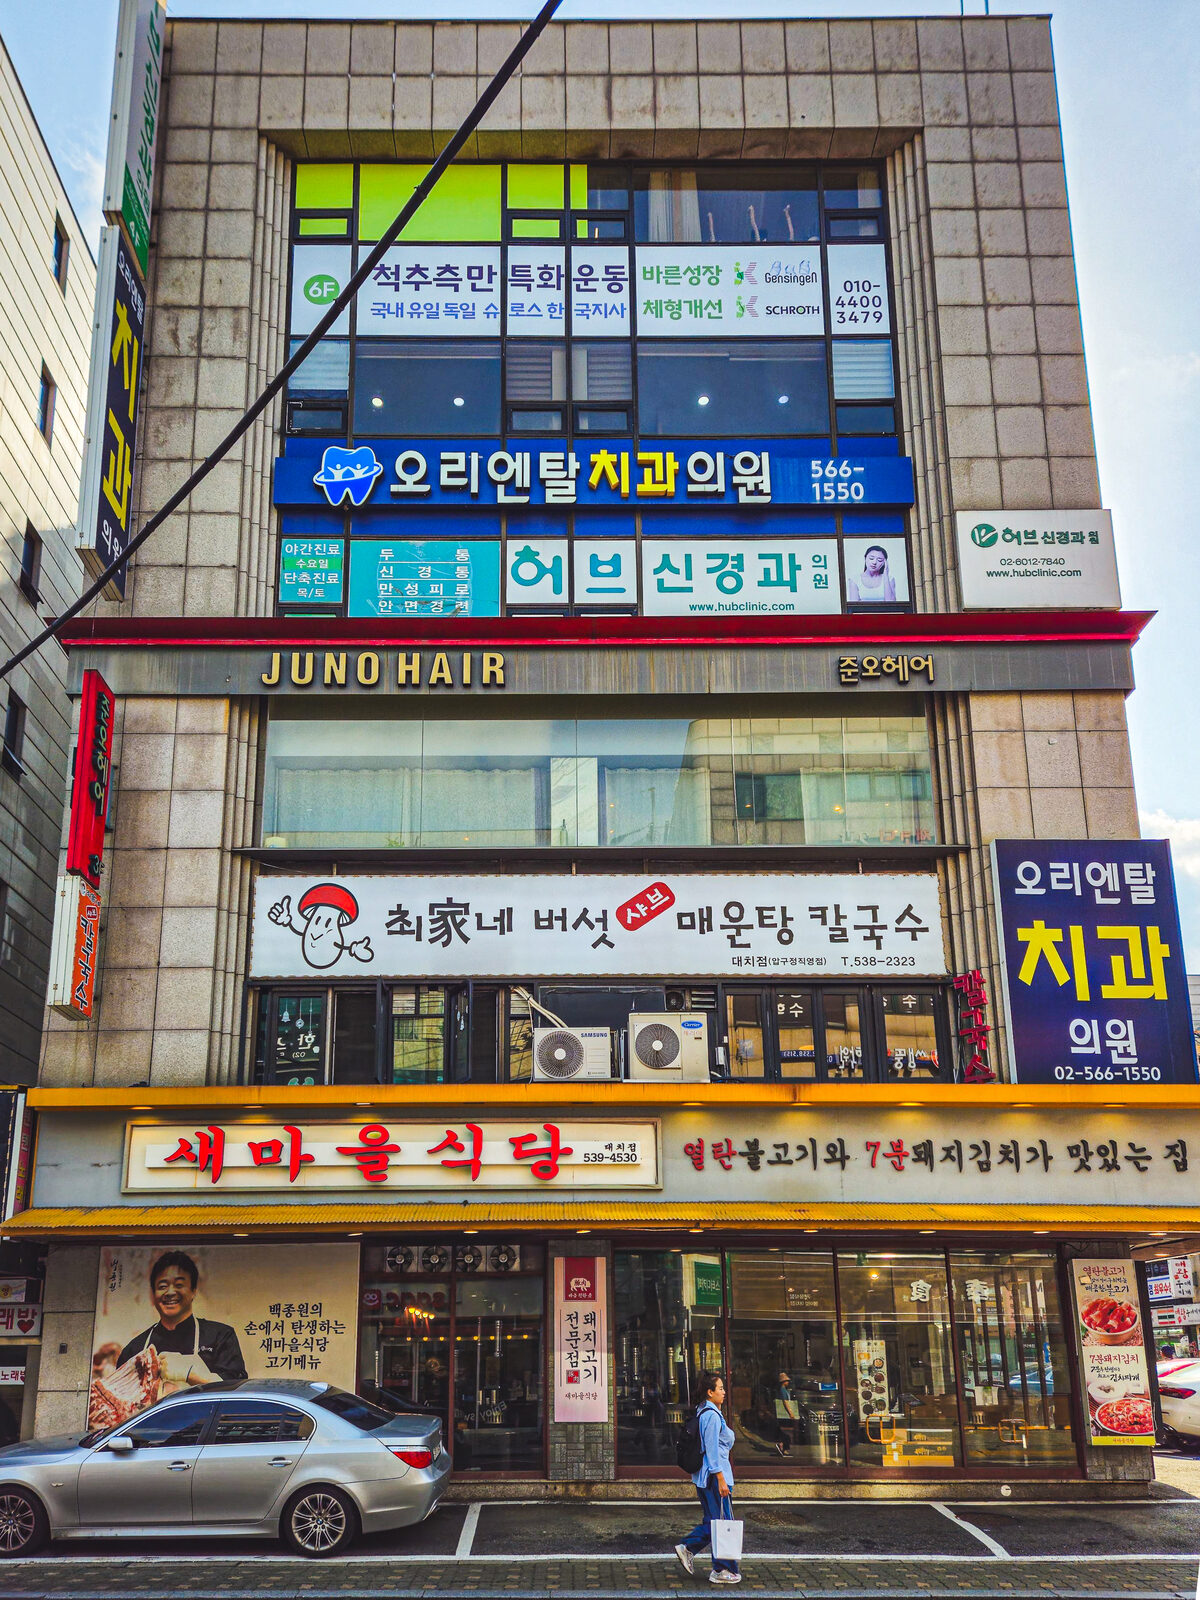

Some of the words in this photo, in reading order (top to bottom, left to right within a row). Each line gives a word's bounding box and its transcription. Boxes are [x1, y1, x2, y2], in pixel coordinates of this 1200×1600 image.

[372, 263, 498, 293] 척추측만
[508, 264, 566, 292] 특화
[572, 264, 629, 294] 운동
[641, 262, 723, 286] 바른성장
[308, 281, 336, 298] 6F
[843, 279, 881, 293] 010-
[642, 299, 723, 321] 체형개선
[765, 305, 820, 315] SCHROTH
[835, 295, 882, 308] 4400
[836, 311, 883, 324] 3479
[102, 298, 139, 532] 치과
[811, 459, 865, 478] 566-
[811, 482, 865, 501] 1550
[1001, 527, 1039, 546] 허브
[1041, 530, 1086, 546] 신경과
[284, 543, 341, 556] 야간진료
[295, 558, 329, 570] 수요일
[986, 568, 1082, 578] www.hubclinic.com
[284, 571, 340, 586] 단축진료
[652, 552, 802, 596] 신경과
[297, 587, 326, 598] 목/토
[688, 601, 795, 613] www.hubclinic.com
[261, 651, 380, 686] JUNO
[396, 651, 506, 685] HAIR
[838, 655, 936, 685] 준오헤어
[1015, 861, 1156, 905] 오리엔탈
[626, 887, 671, 926] 샤브
[534, 907, 616, 950] 버섯
[676, 901, 795, 949] 매운탕
[808, 903, 930, 950] 칼국수
[73, 914, 97, 1011] 칼국수
[1016, 920, 1170, 1001] 치과
[682, 1021, 703, 1030] Carrier
[952, 969, 997, 1083] 칼국수
[1069, 1018, 1138, 1065] 의원
[1054, 1066, 1161, 1081] 02-566-1550
[163, 1123, 573, 1184] 새마을식당
[583, 1152, 638, 1163] 539-4530
[683, 1138, 850, 1171] 열탄불고기와
[1067, 1139, 1152, 1173] 맛있는
[1163, 1138, 1188, 1173] 집
[268, 1302, 324, 1319] 백종원의
[243, 1320, 286, 1336] 손에서
[290, 1320, 347, 1336] 탄생하는
[259, 1336, 330, 1354] 새마을식당
[565, 1311, 581, 1369] 전문점
[582, 1311, 598, 1385] 돼지고기
[264, 1354, 322, 1371] 고기메뉴
